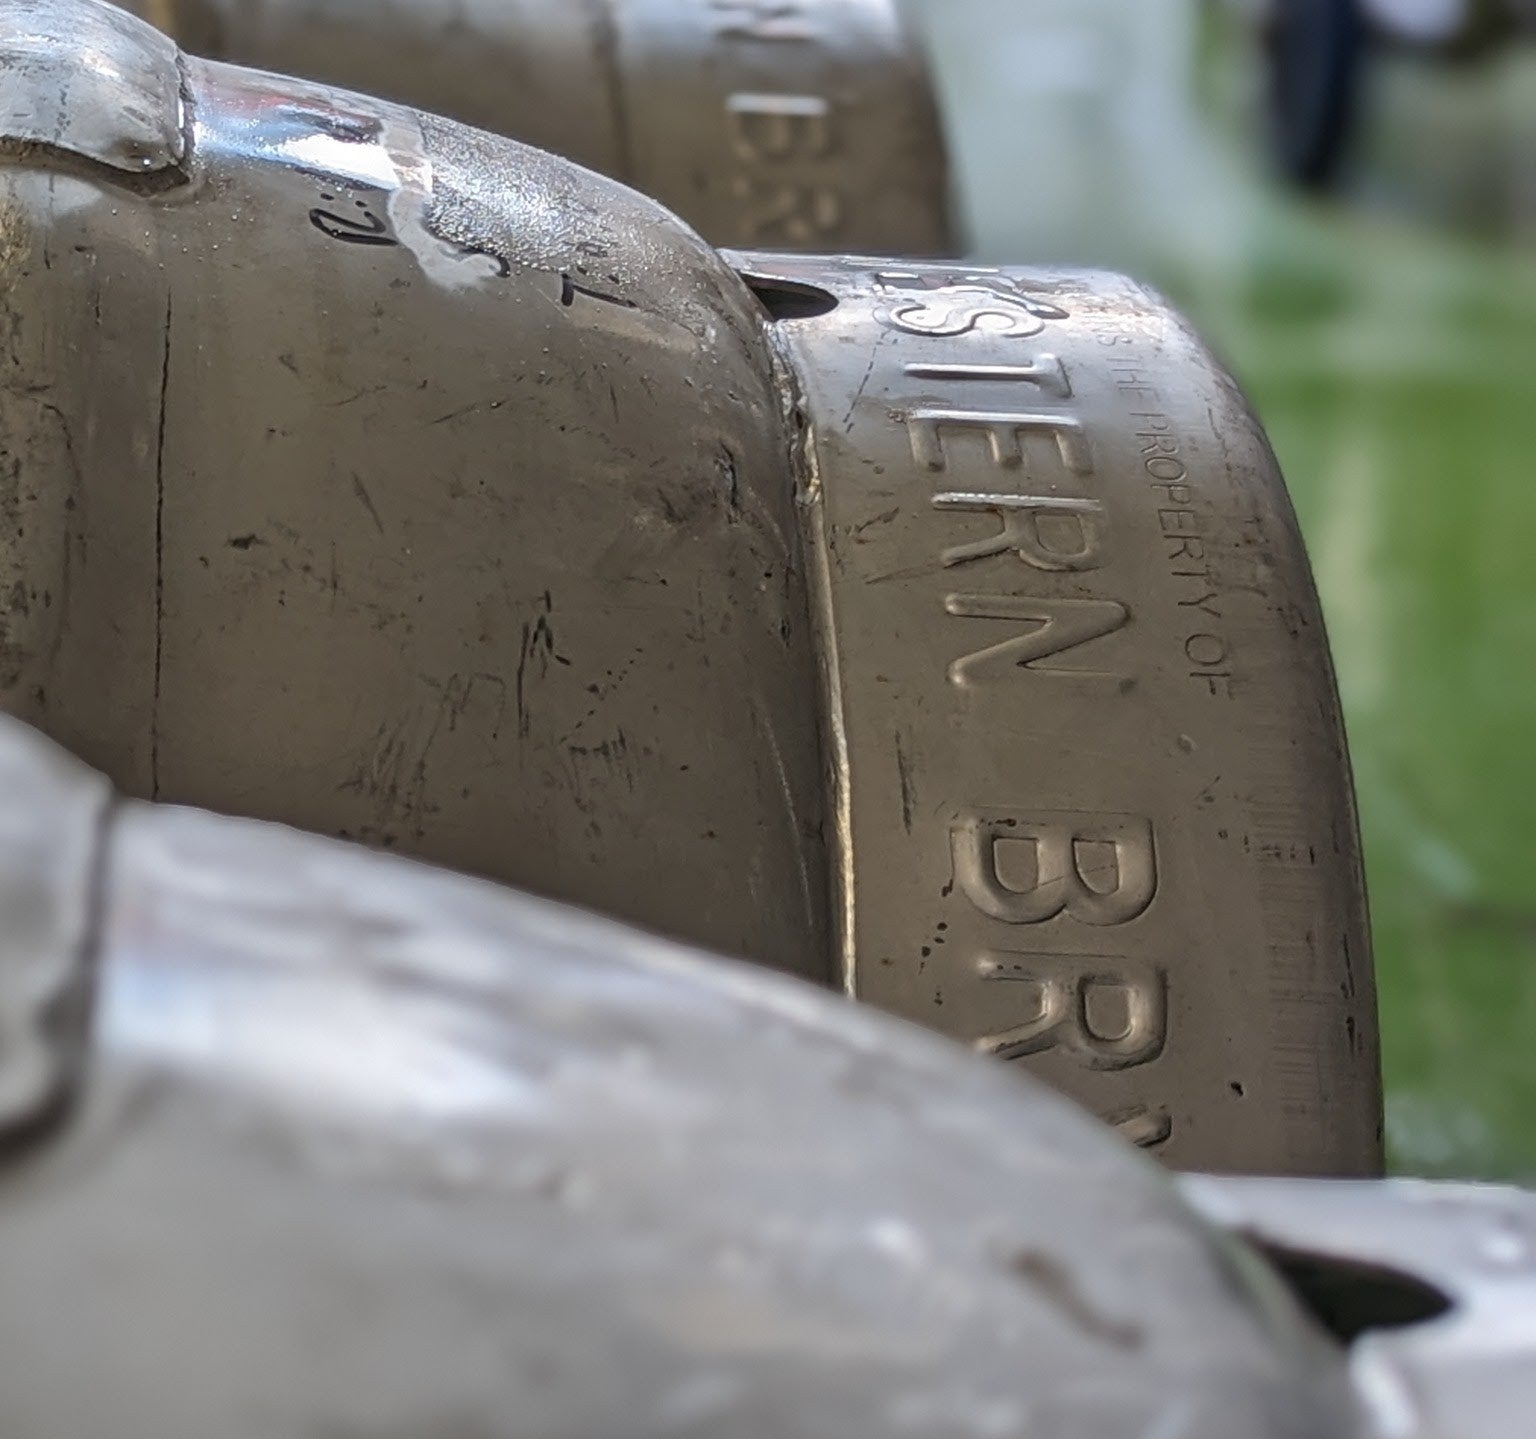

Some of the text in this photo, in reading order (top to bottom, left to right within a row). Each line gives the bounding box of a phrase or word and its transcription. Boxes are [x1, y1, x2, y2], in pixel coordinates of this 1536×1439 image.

[1106, 357, 1235, 702] THE PROPERTY OF
